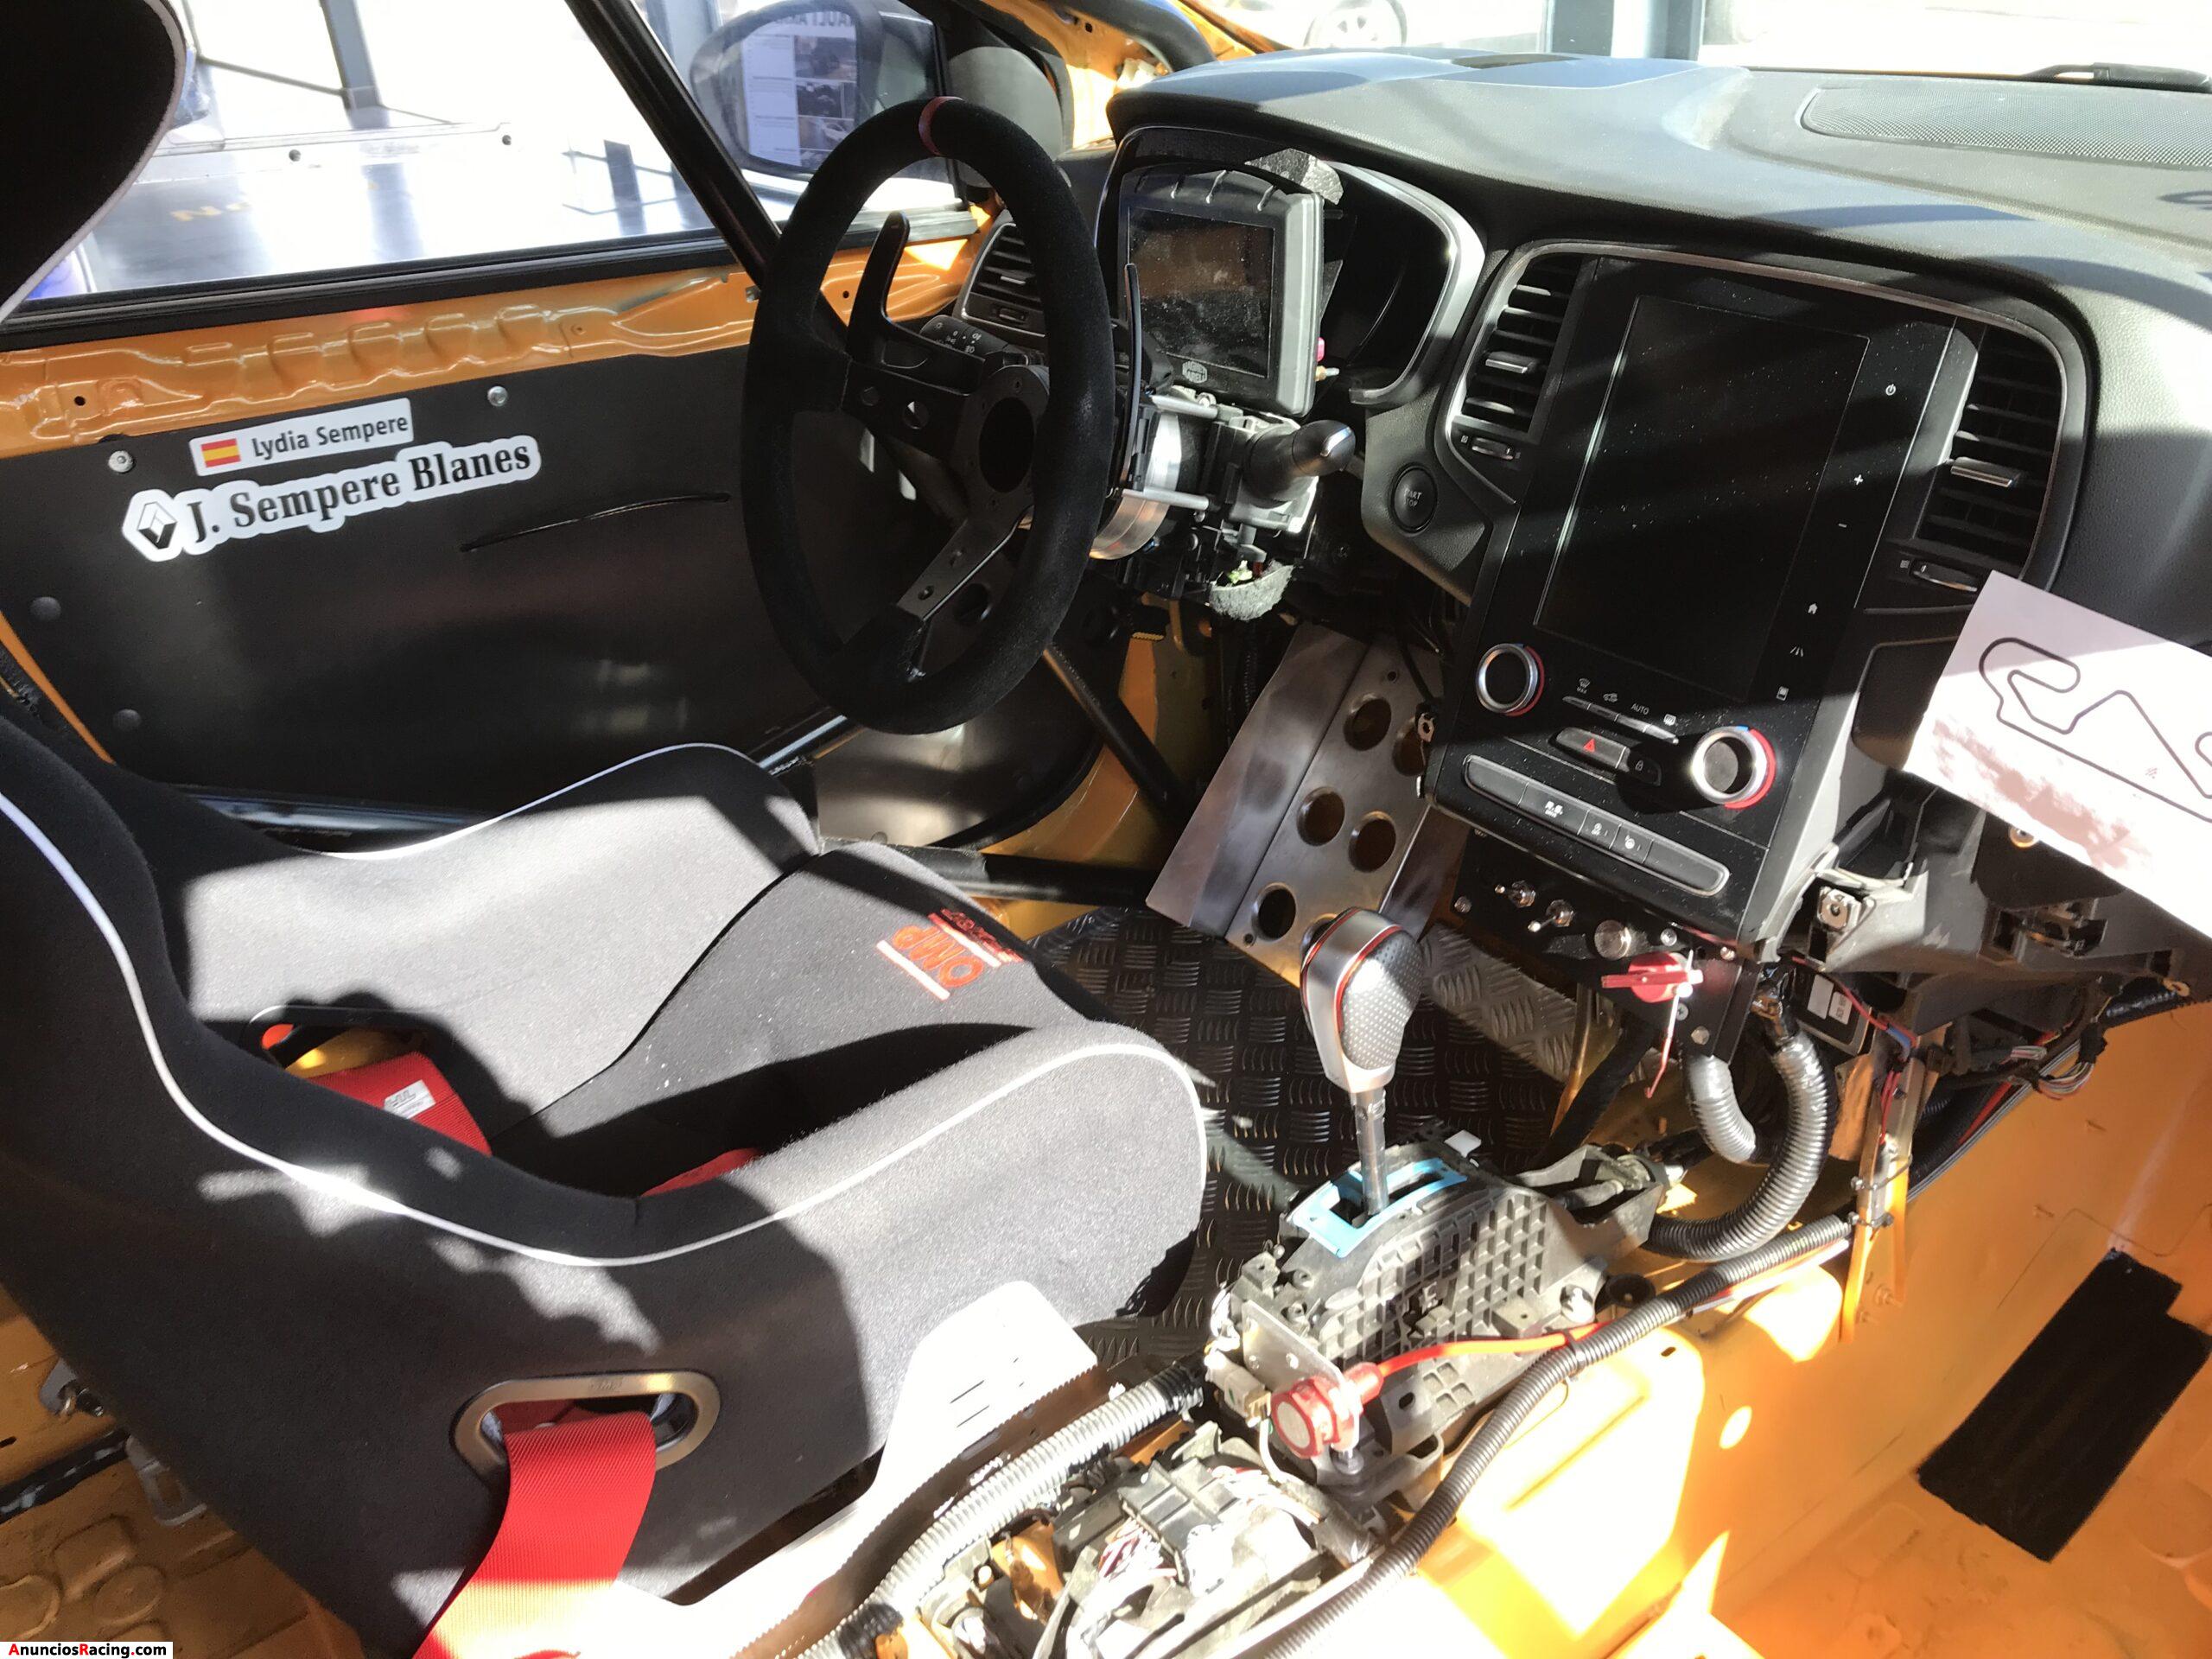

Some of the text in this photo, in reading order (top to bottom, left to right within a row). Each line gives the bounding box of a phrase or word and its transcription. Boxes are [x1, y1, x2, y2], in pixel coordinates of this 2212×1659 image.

[251, 415, 409, 461] Lydia Sempere
[187, 445, 531, 543] J. Sempere Blanes
[1631, 703, 1649, 715] AUTO
[892, 925, 985, 988] OMP
